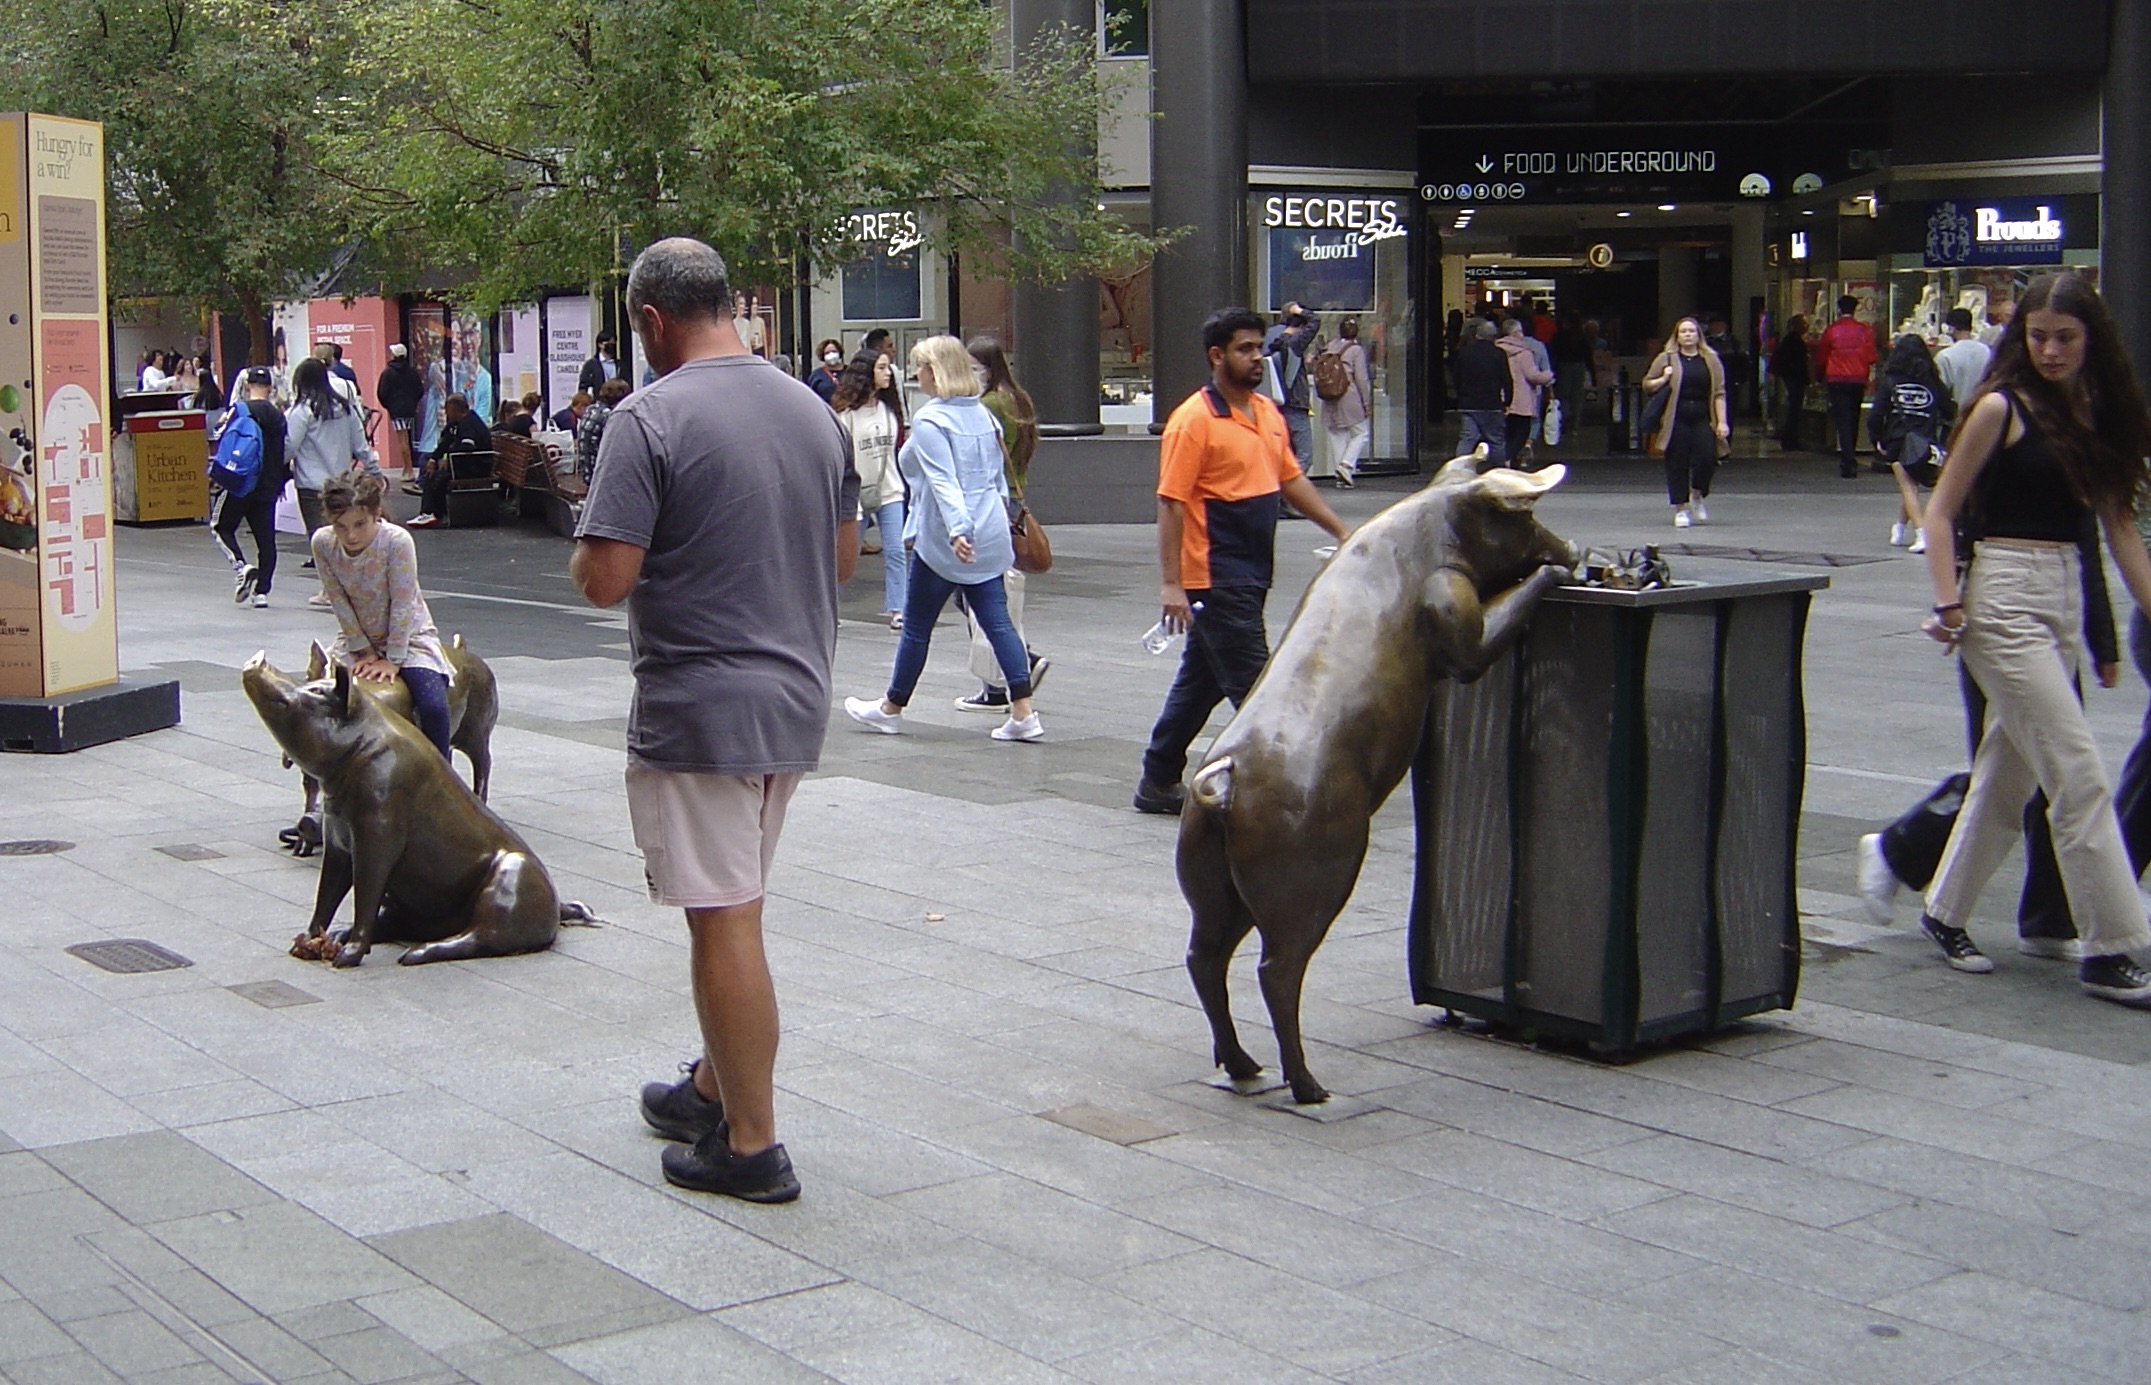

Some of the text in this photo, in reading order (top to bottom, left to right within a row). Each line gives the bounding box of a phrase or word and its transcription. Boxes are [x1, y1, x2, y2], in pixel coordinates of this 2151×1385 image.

[36, 130, 94, 161] Hungry for
[37, 159, 72, 180] a win?
[1504, 151, 1715, 174] FOOD UNDERGROUND
[1264, 197, 1397, 227] SECRETS
[1975, 206, 2062, 241] Prouds
[1978, 245, 1999, 253] THE
[147, 453, 187, 467] Urban
[147, 468, 197, 483] Kitchen
